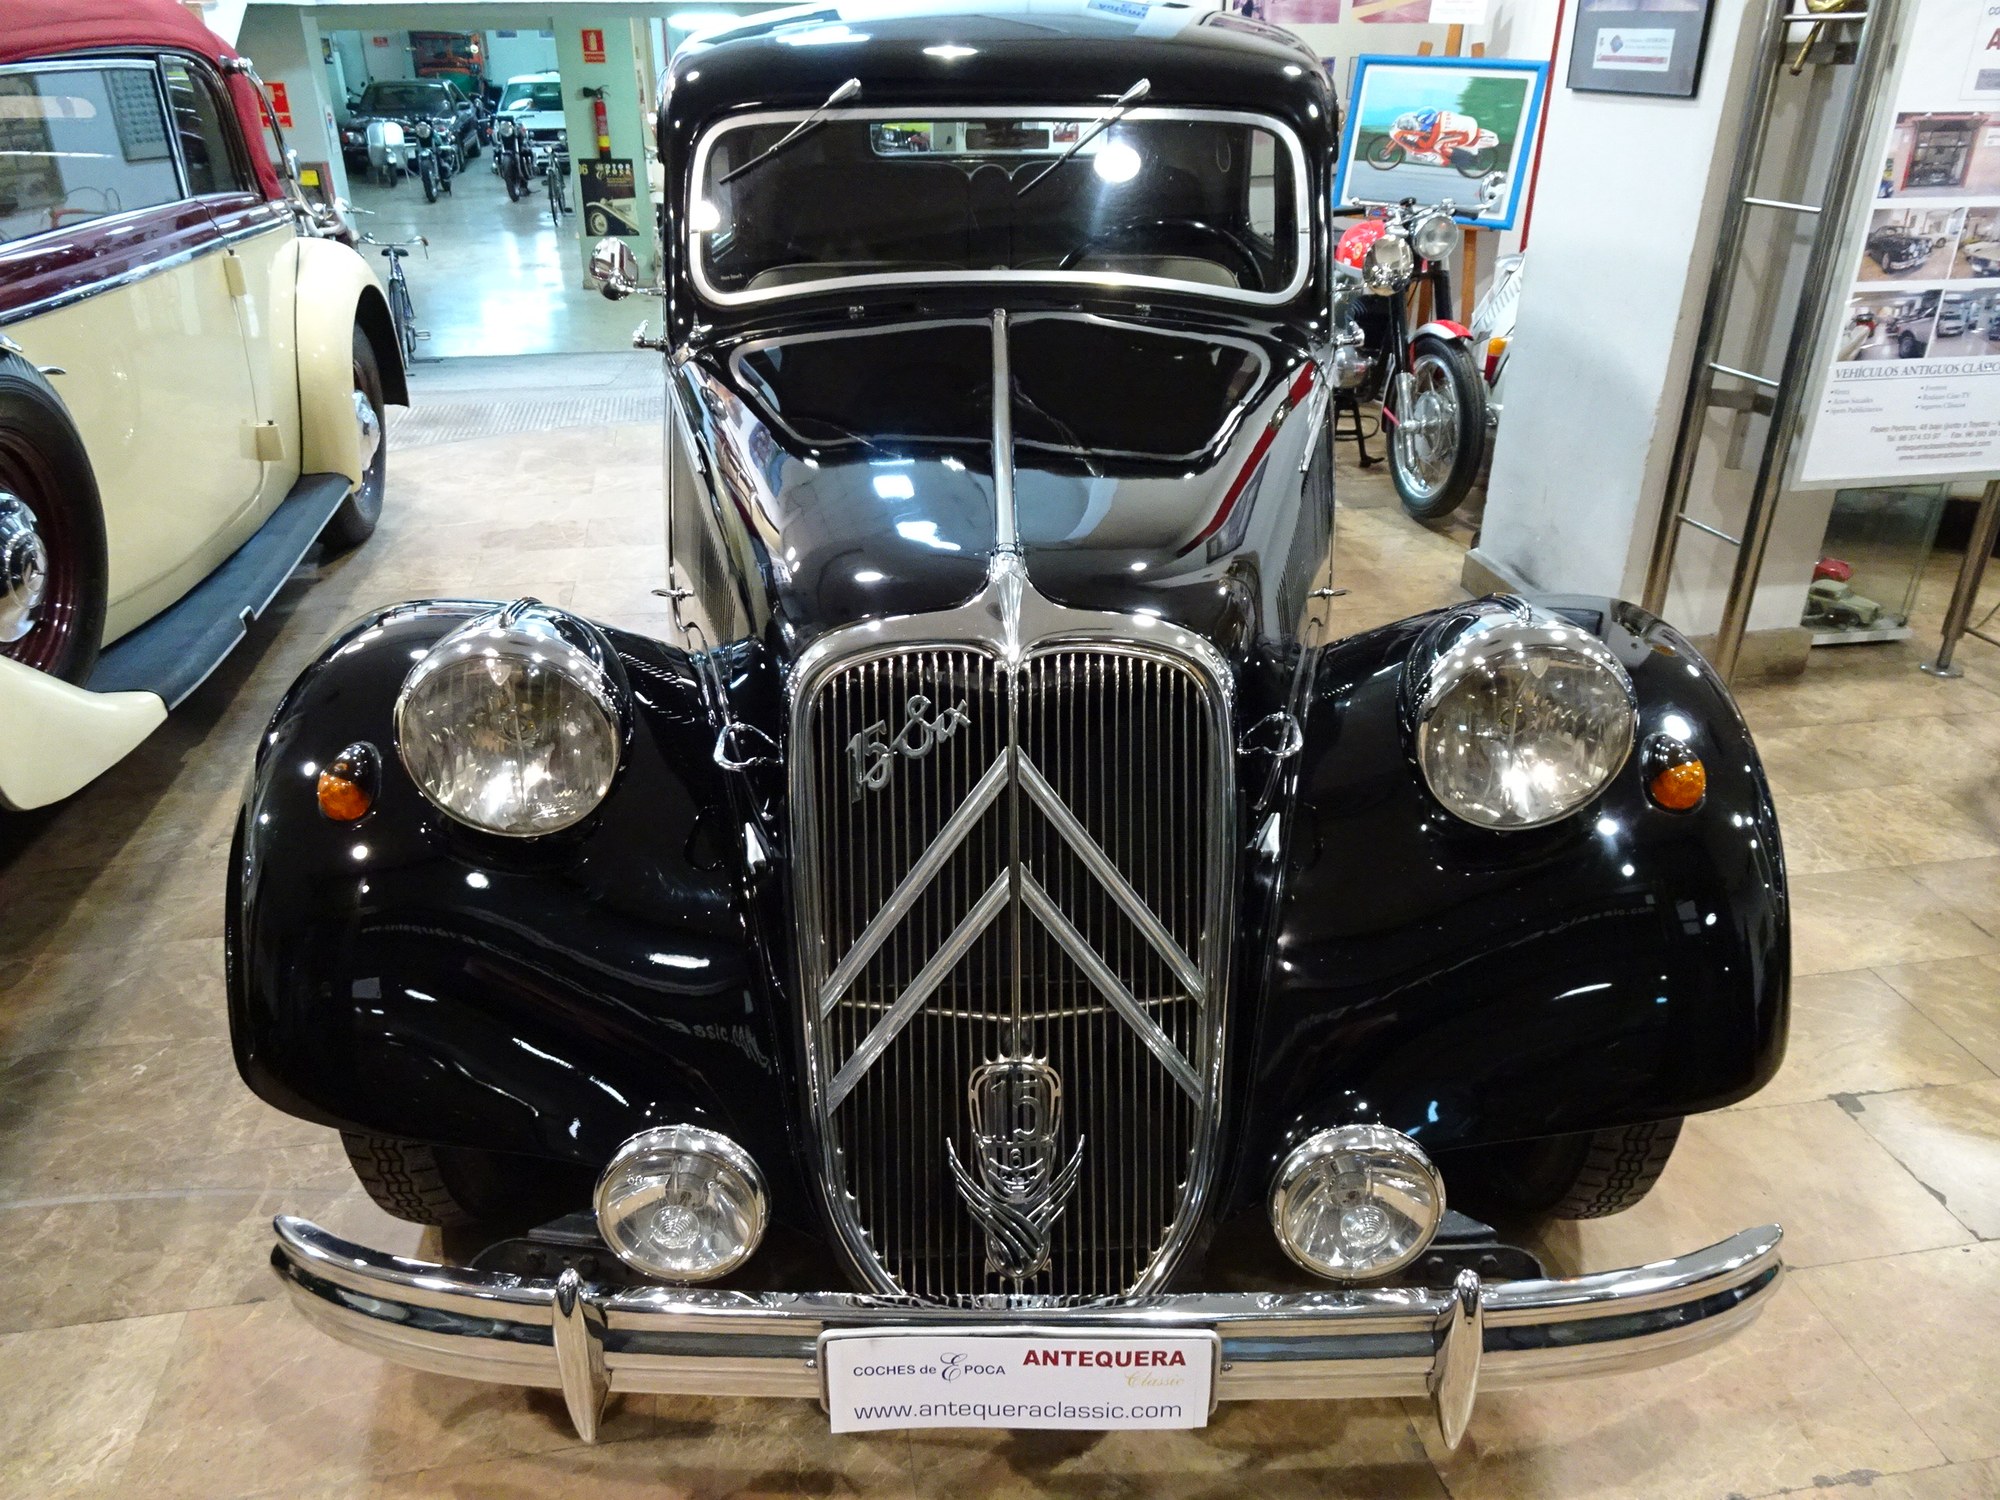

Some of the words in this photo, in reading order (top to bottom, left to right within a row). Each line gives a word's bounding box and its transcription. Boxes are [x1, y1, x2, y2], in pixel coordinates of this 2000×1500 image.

[1836, 365, 1899, 378] VEHÍCULOS
[1899, 363, 1959, 376] ANTIGUOS
[845, 719, 891, 804] 15
[1022, 1349, 1187, 1368] ANTEQUERA
[852, 1364, 916, 1377] COCHES
[918, 1364, 938, 1376] de
[853, 1400, 1183, 1421] www.antequeraclassic.com
